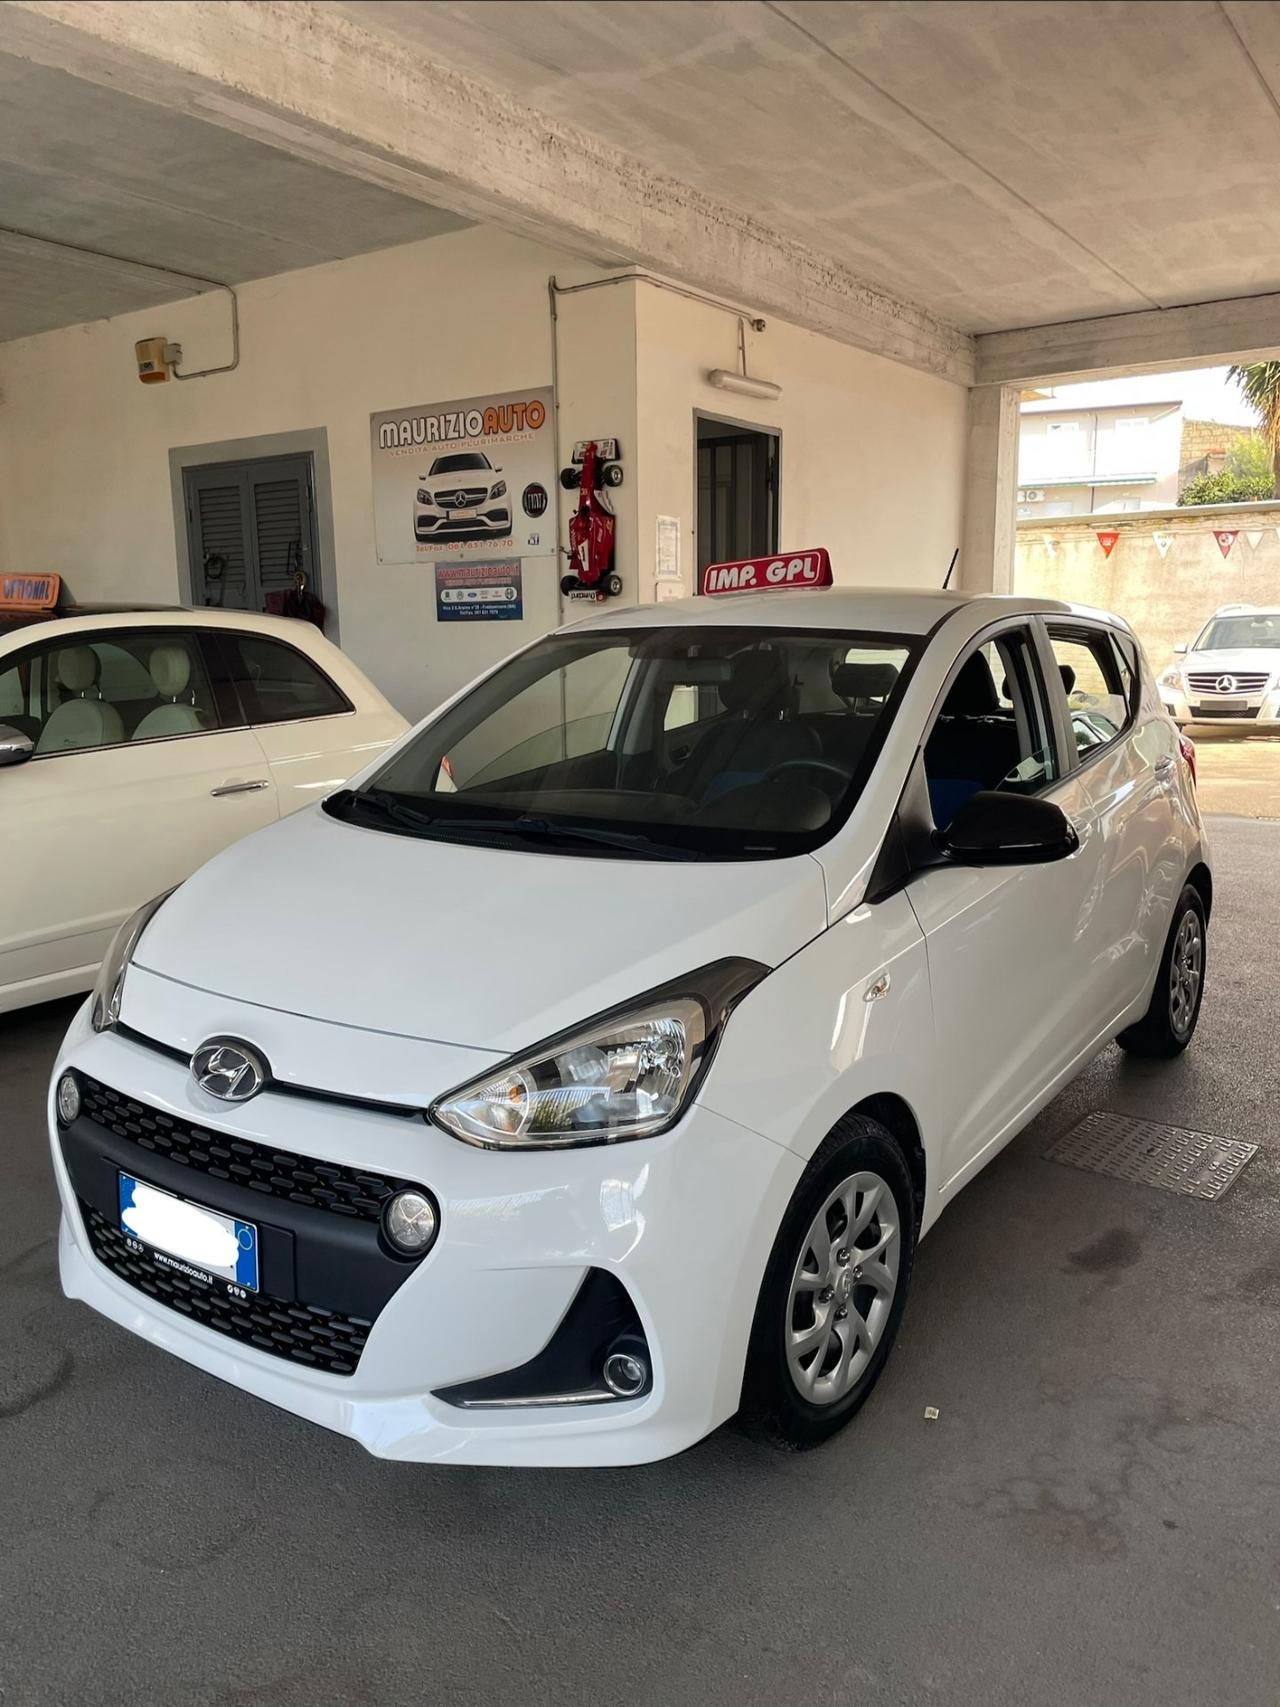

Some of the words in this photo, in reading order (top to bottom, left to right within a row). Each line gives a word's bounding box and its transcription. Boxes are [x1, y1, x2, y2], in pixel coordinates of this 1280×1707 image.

[389, 447, 427, 457] VENDITA
[431, 443, 457, 452] AUTO
[461, 433, 535, 448] PLURIMARCHE
[709, 565, 757, 591] IMP.
[765, 557, 815, 583] GPL
[153, 1251, 214, 1285] www.maurizioauto.it
